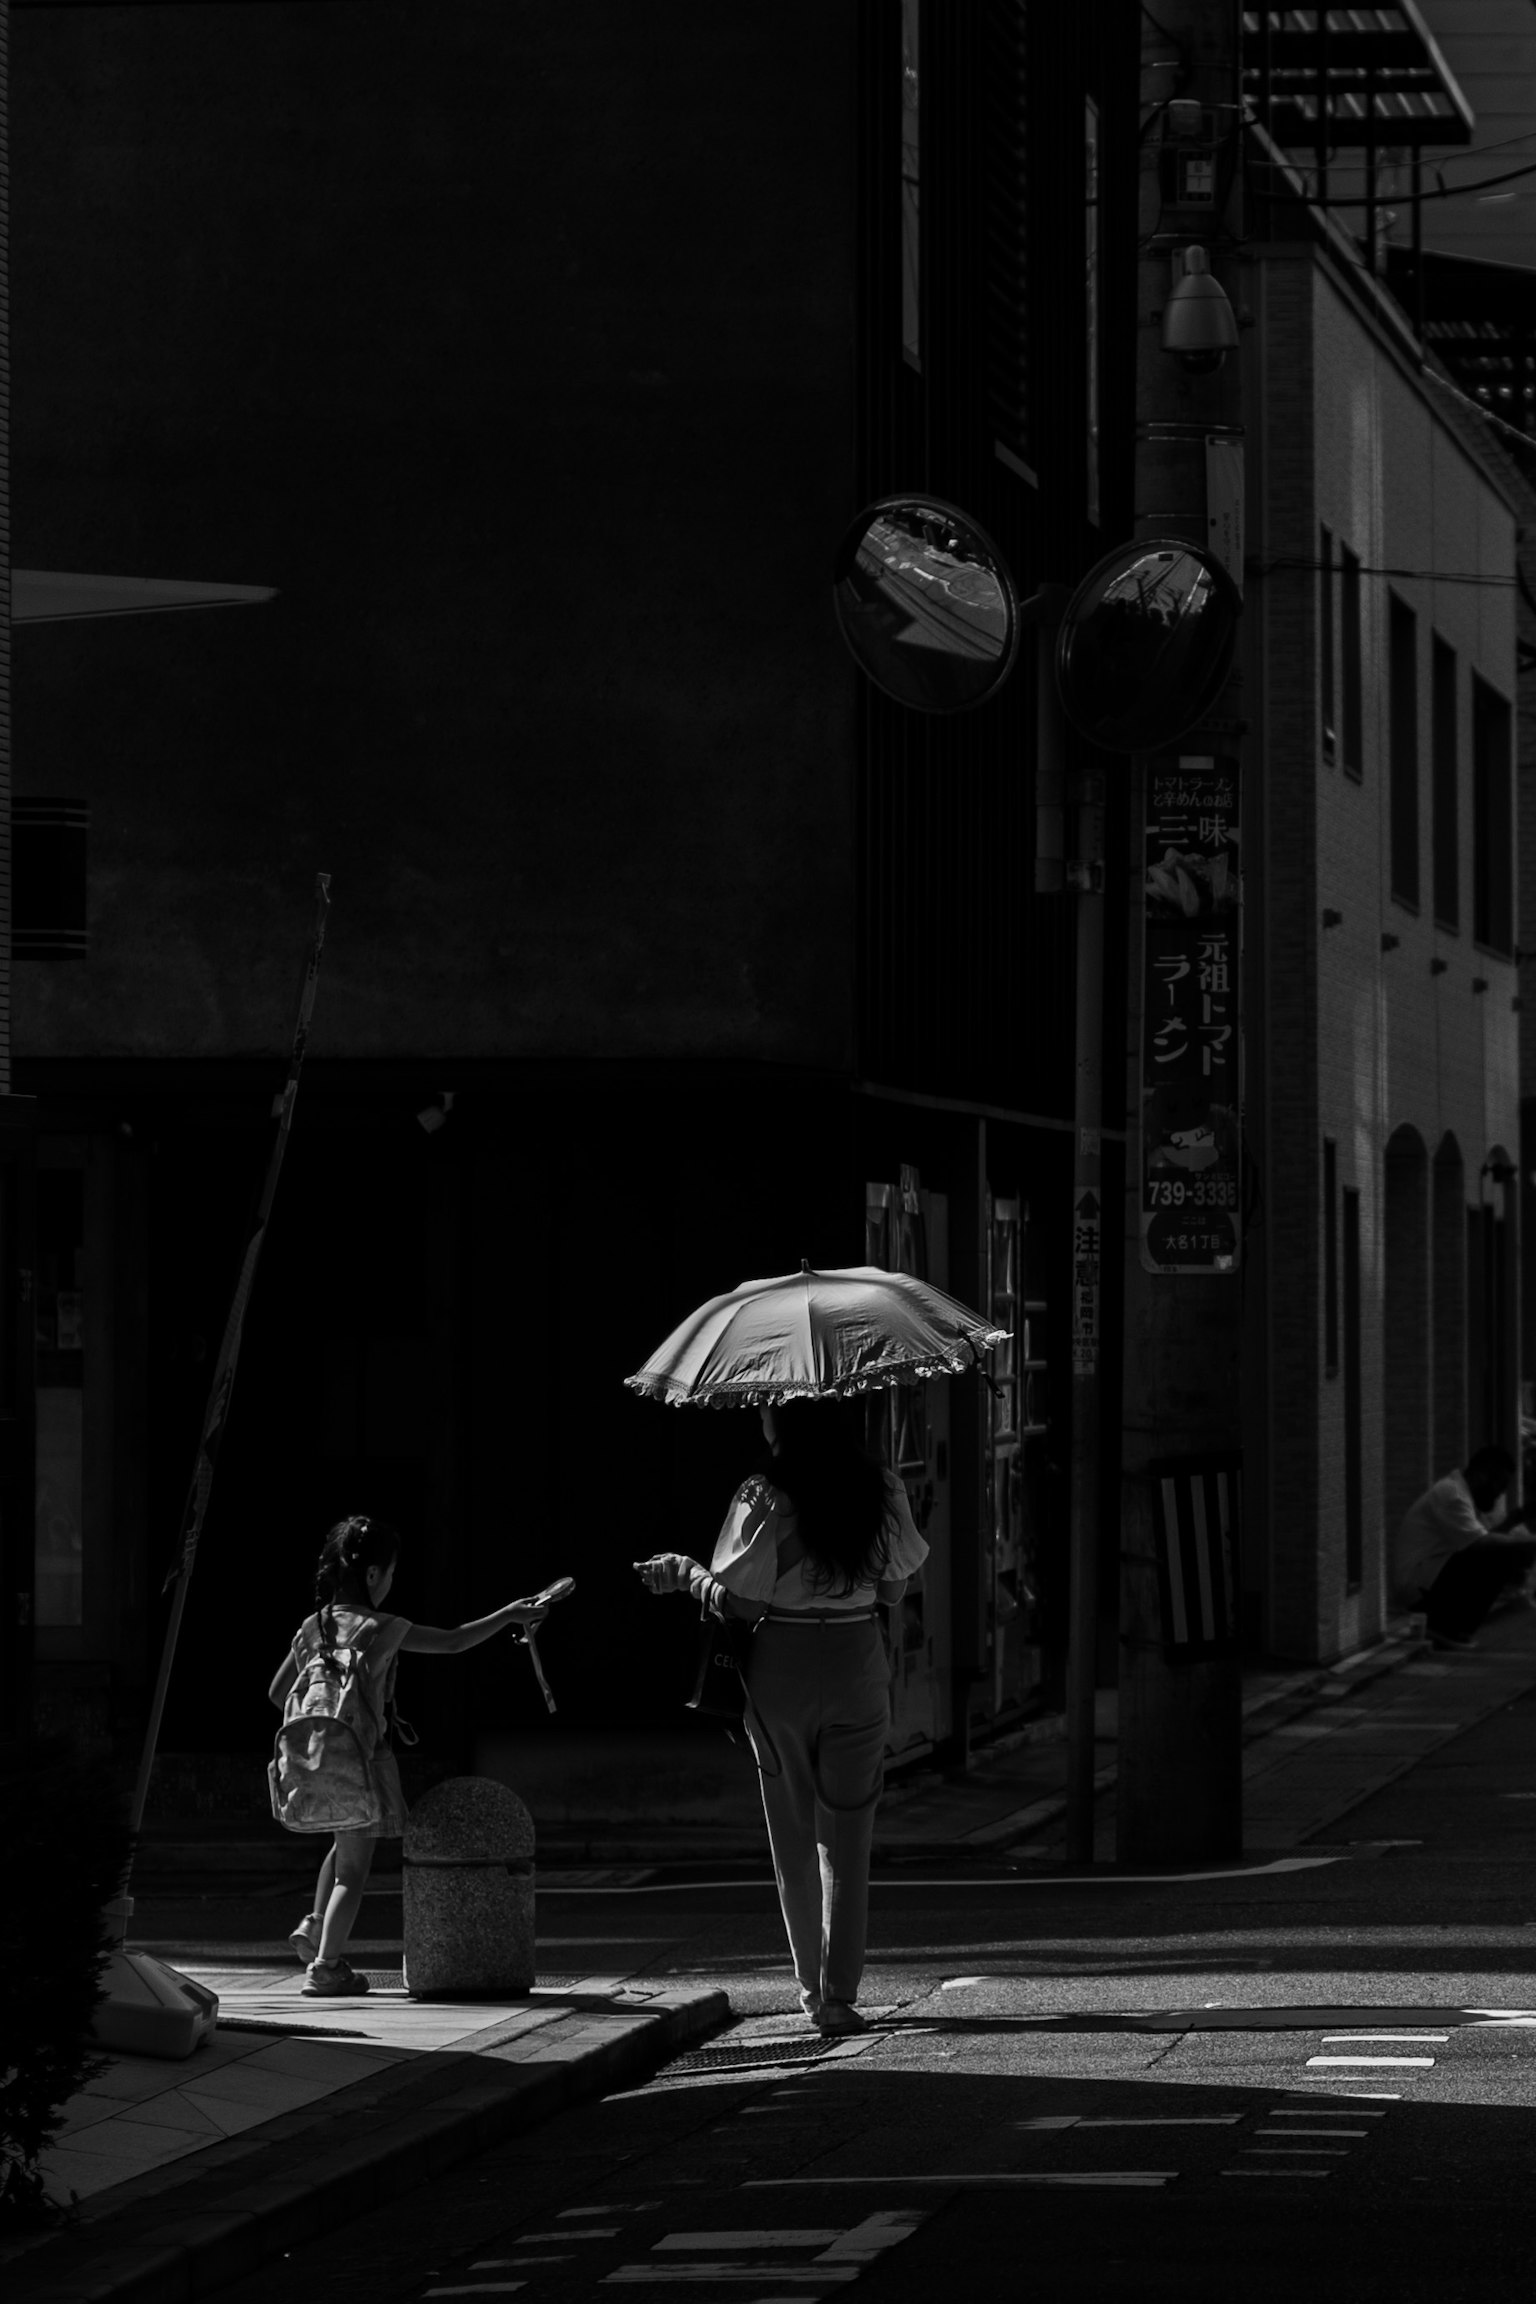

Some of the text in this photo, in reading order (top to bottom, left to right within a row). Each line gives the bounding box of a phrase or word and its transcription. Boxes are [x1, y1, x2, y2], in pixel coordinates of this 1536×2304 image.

[1154, 773, 1234, 791] トマトラーメン
[1153, 791, 1233, 808] と辛めんのお店
[1158, 813, 1227, 847] 三味
[1153, 952, 1190, 1062] ラーメン
[1196, 930, 1232, 1076] 元祖トマト
[1148, 1181, 1236, 1206] 739-3335
